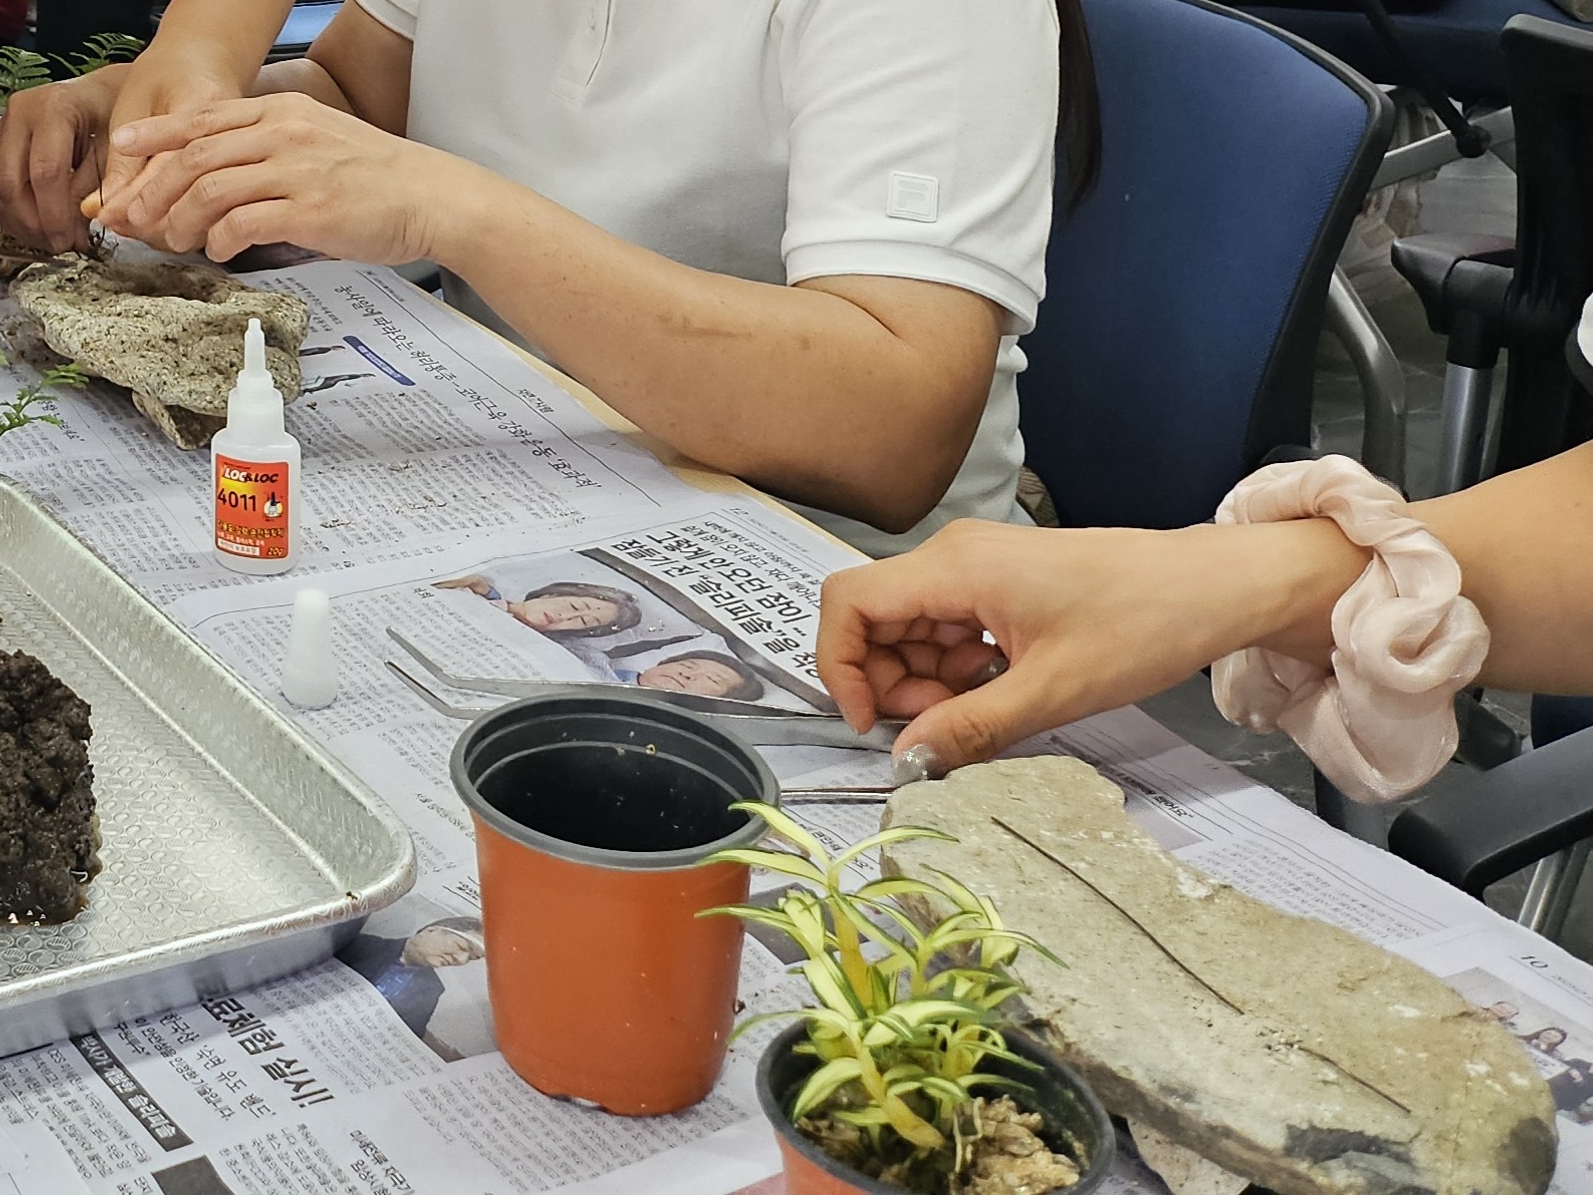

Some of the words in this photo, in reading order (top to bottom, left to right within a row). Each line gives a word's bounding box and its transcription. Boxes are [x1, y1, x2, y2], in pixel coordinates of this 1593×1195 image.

[217, 487, 257, 512] 4011
[611, 538, 680, 567] 잠들기
[661, 564, 701, 578] 전
[646, 530, 715, 561] 그렇게
[717, 568, 775, 594] 오던
[1520, 955, 1549, 969] 10
[200, 997, 285, 1056] 료체험
[261, 1057, 335, 1108] 실시!
[81, 1035, 112, 1066] 박사가
[104, 1064, 137, 1094] 개발한
[128, 1093, 178, 1139] 슬리피솔
[215, 1070, 248, 1094] 유도
[350, 1129, 389, 1166] 미세전류
